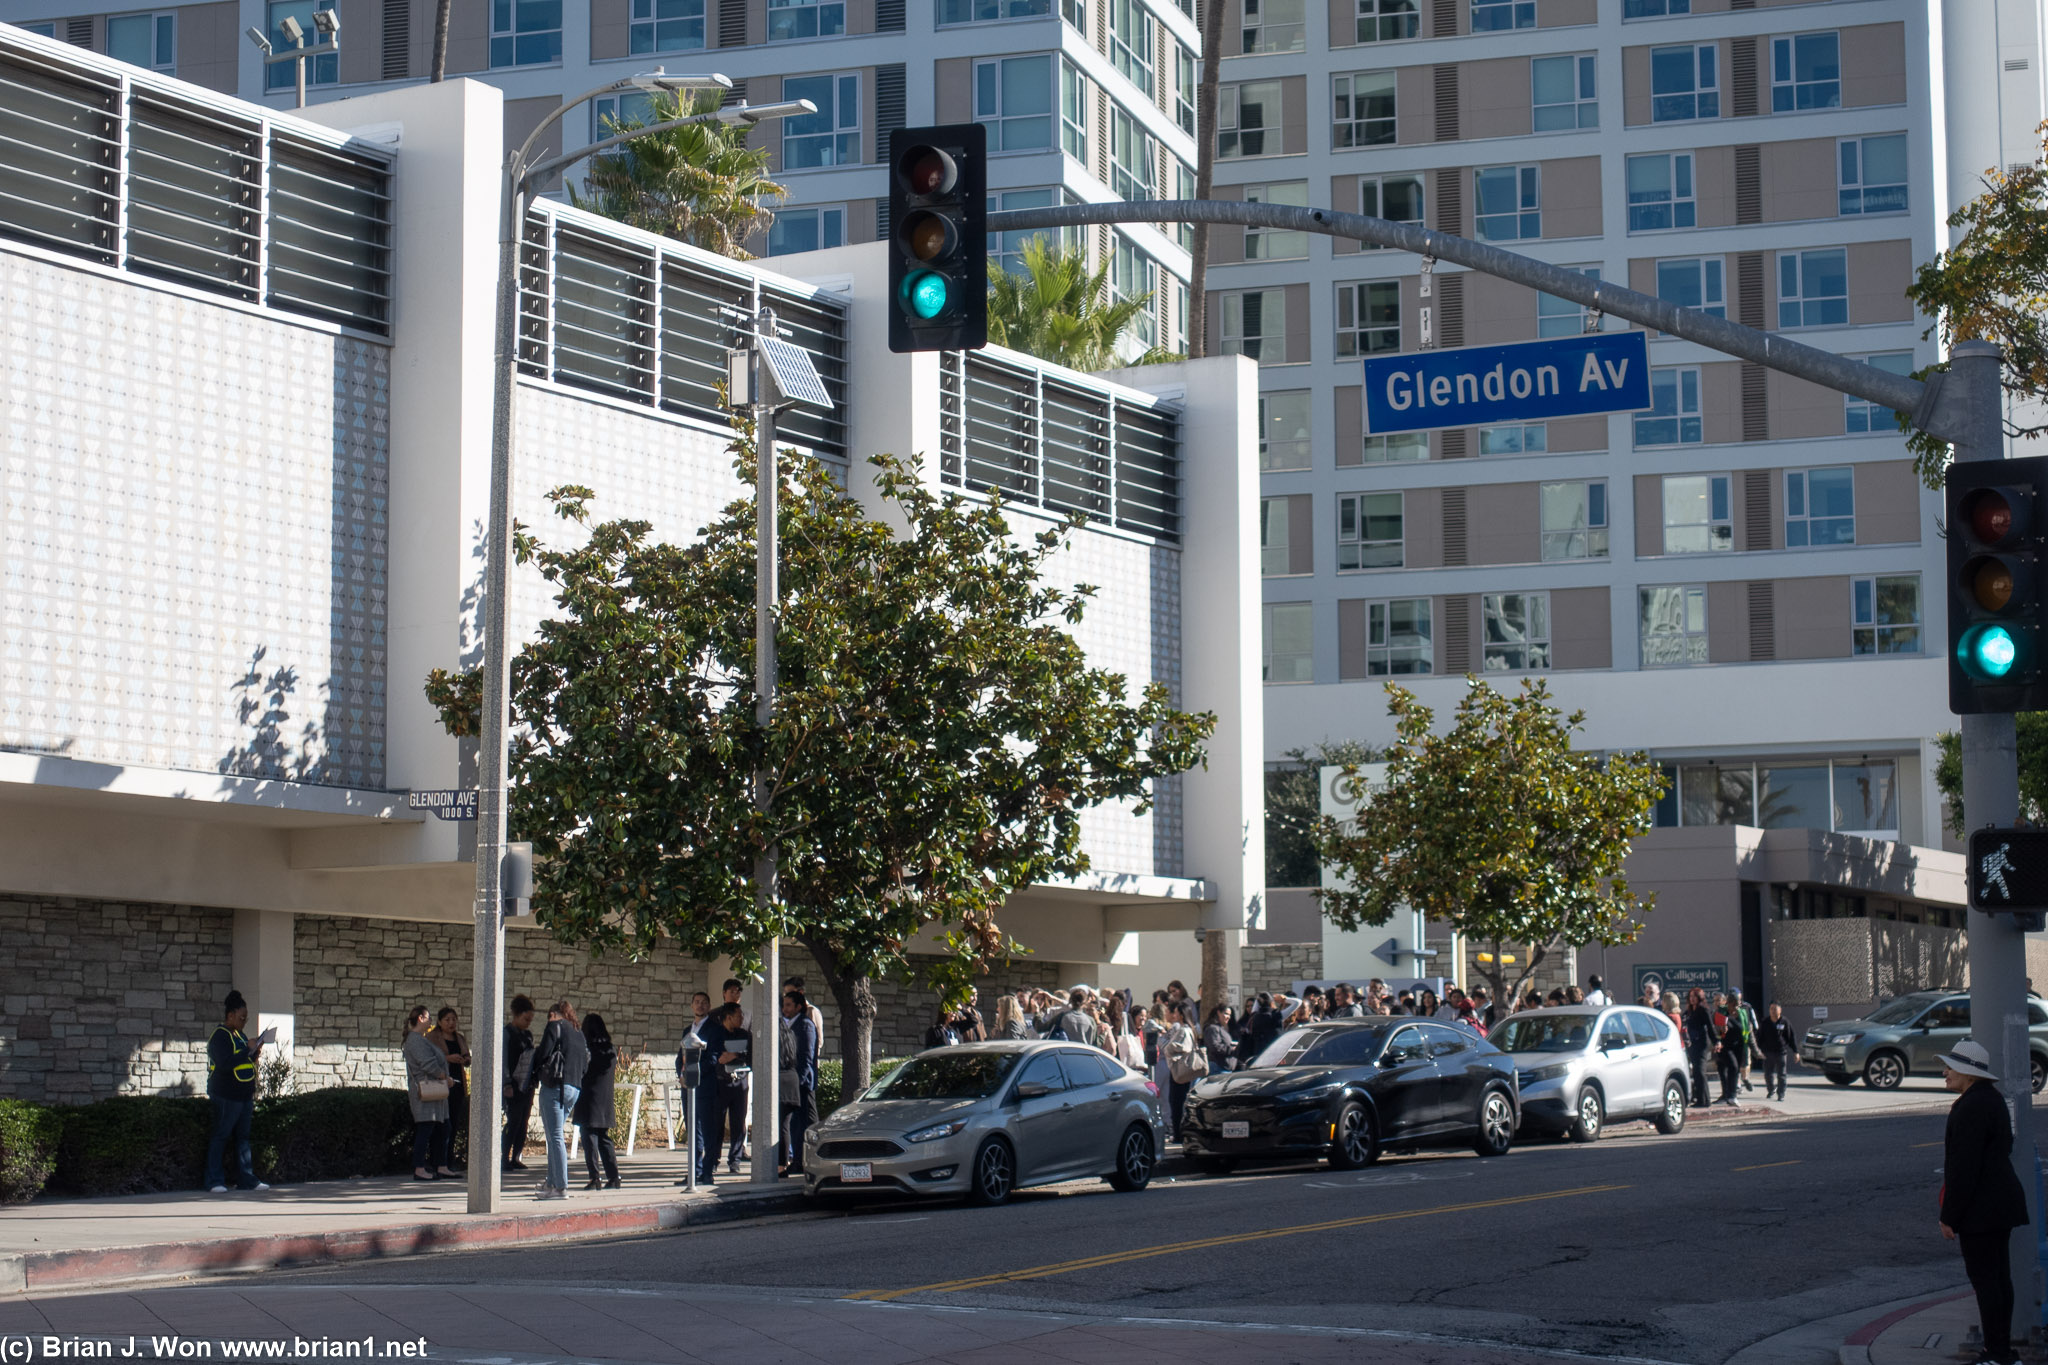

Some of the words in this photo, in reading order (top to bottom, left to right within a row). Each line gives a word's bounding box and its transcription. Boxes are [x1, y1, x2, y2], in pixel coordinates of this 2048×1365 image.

[1386, 362, 1560, 411] Glendon
[1578, 352, 1629, 393] Av
[409, 792, 454, 807] GLENDON
[441, 807, 462, 818] 1000
[466, 807, 474, 818] S.
[1665, 968, 1719, 982] Calligraphy
